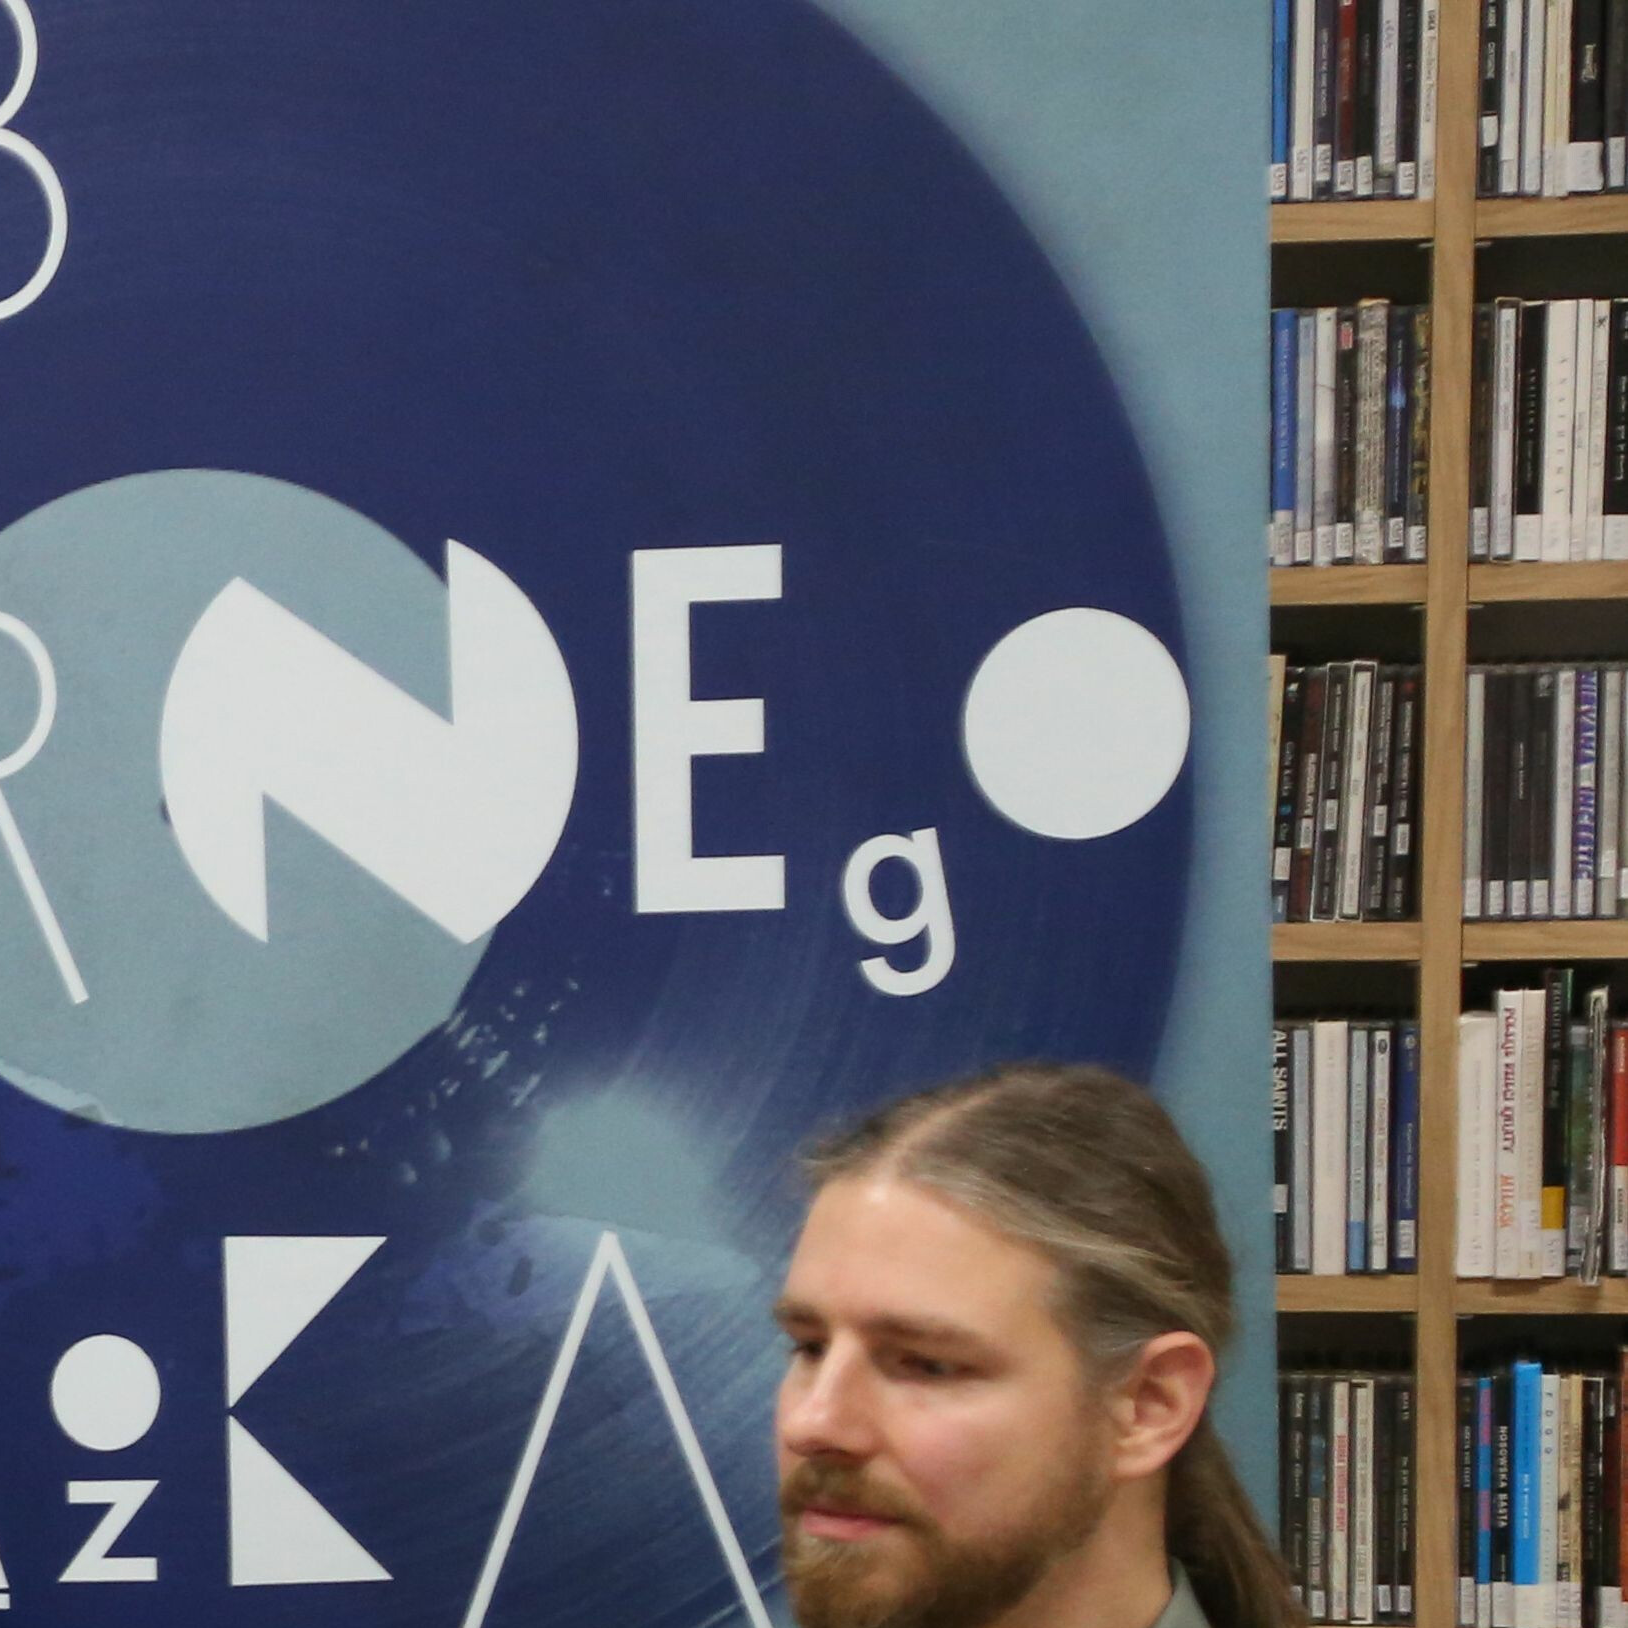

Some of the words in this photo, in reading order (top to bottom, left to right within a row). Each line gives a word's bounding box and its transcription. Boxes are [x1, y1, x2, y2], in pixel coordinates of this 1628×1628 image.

[1273, 1030, 1287, 1062] ALL
[1273, 1067, 1287, 1131] SAINTS
[1499, 1426, 1509, 1488] NOSOWSKA
[1499, 1493, 1509, 1528] BASTA
